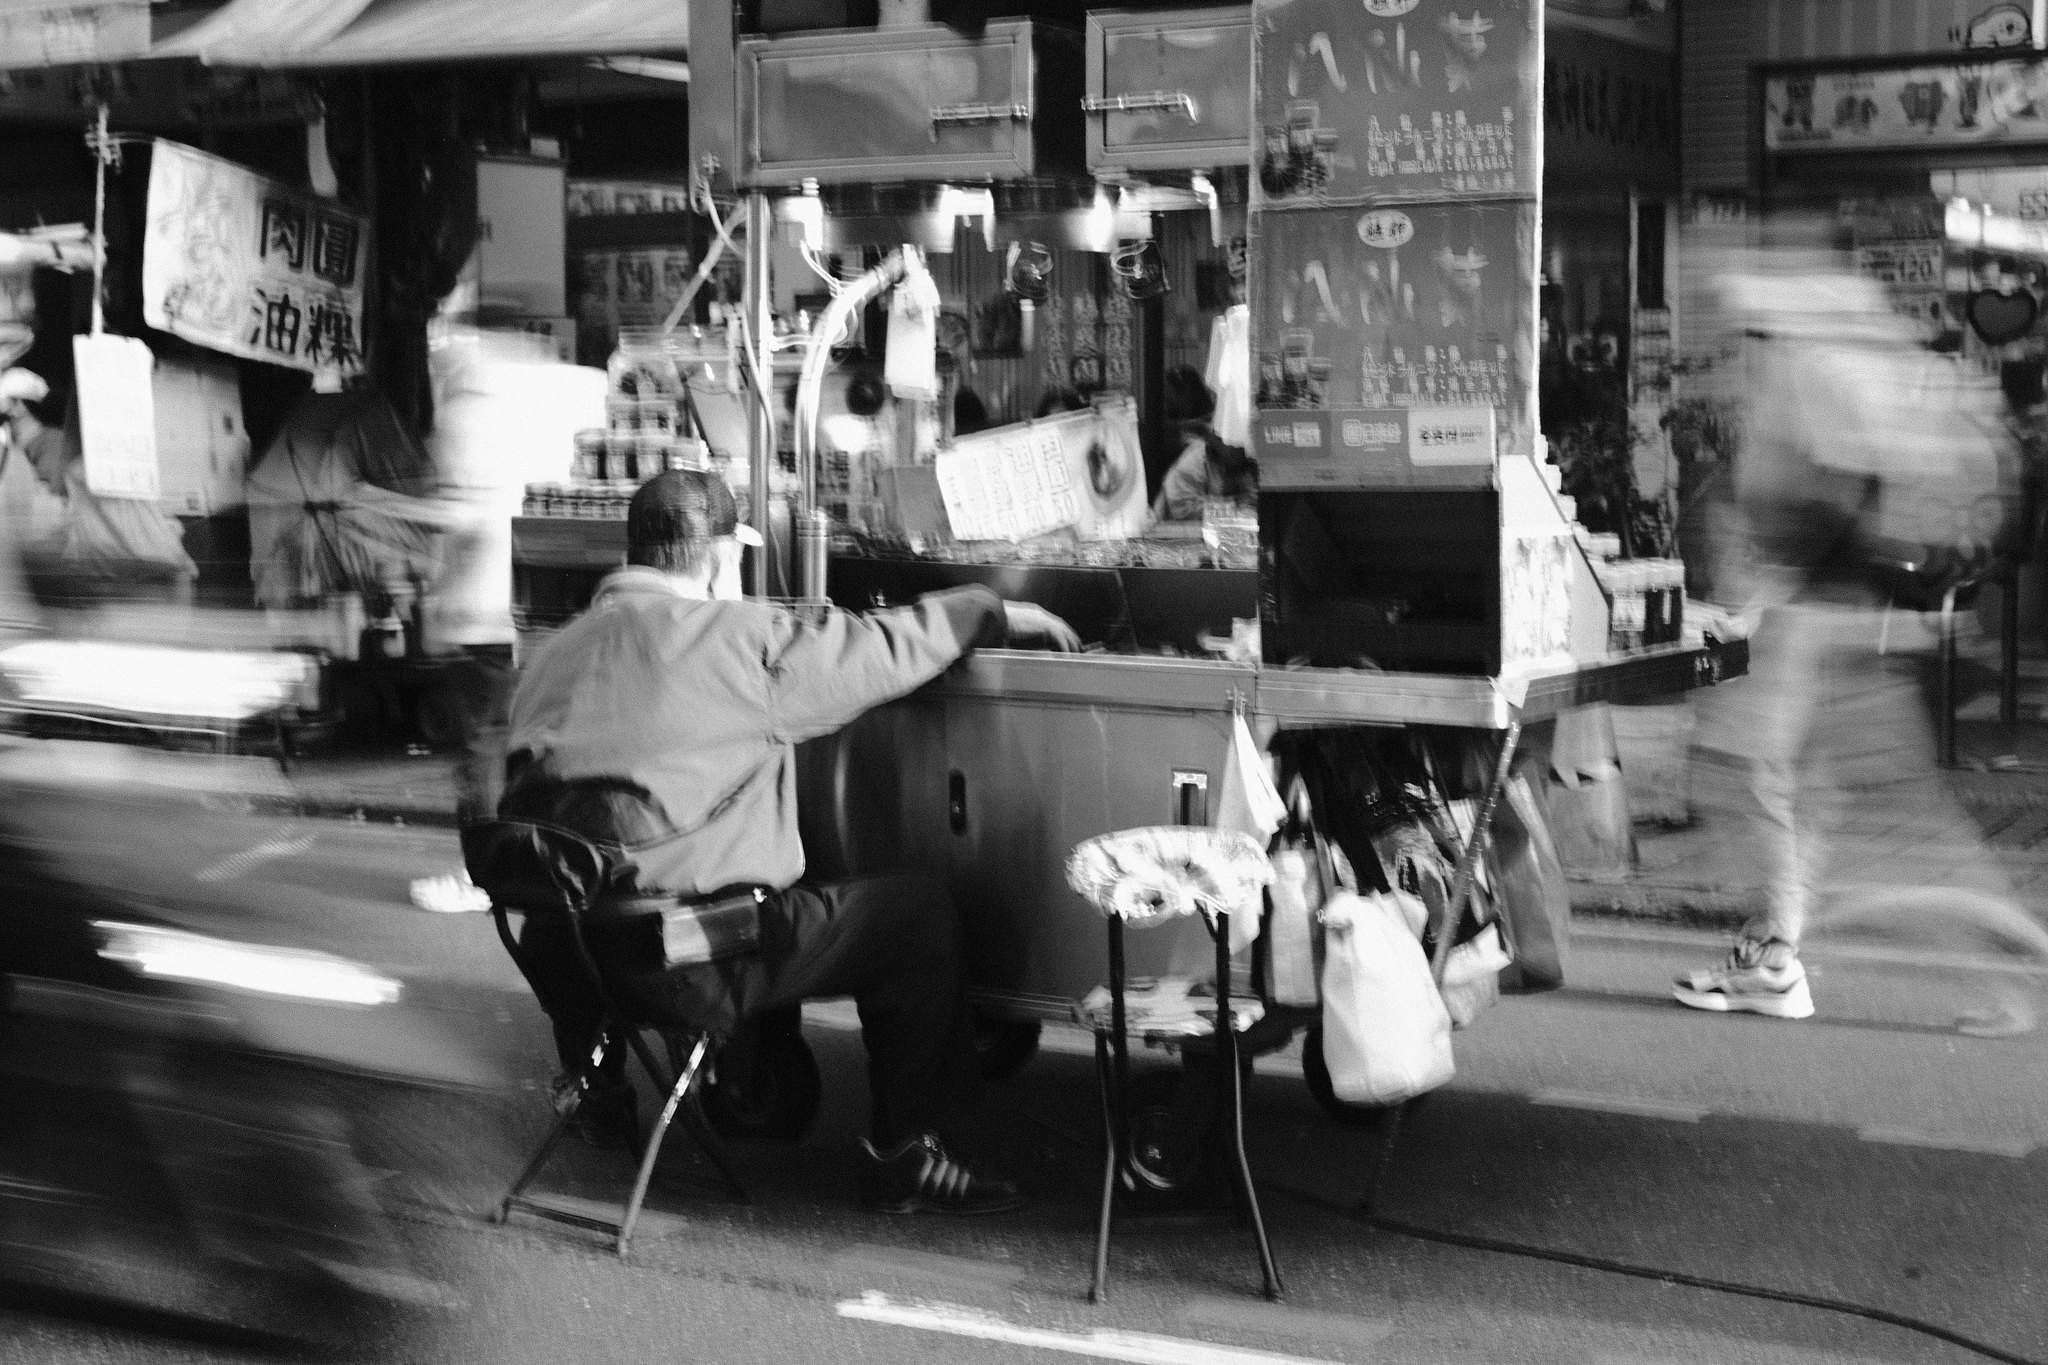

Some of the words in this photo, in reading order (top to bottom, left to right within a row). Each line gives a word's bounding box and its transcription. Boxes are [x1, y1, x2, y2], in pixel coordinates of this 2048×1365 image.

[259, 202, 361, 287] 肉圓
[250, 287, 362, 367] 油粿
[1265, 425, 1293, 443] LINE
